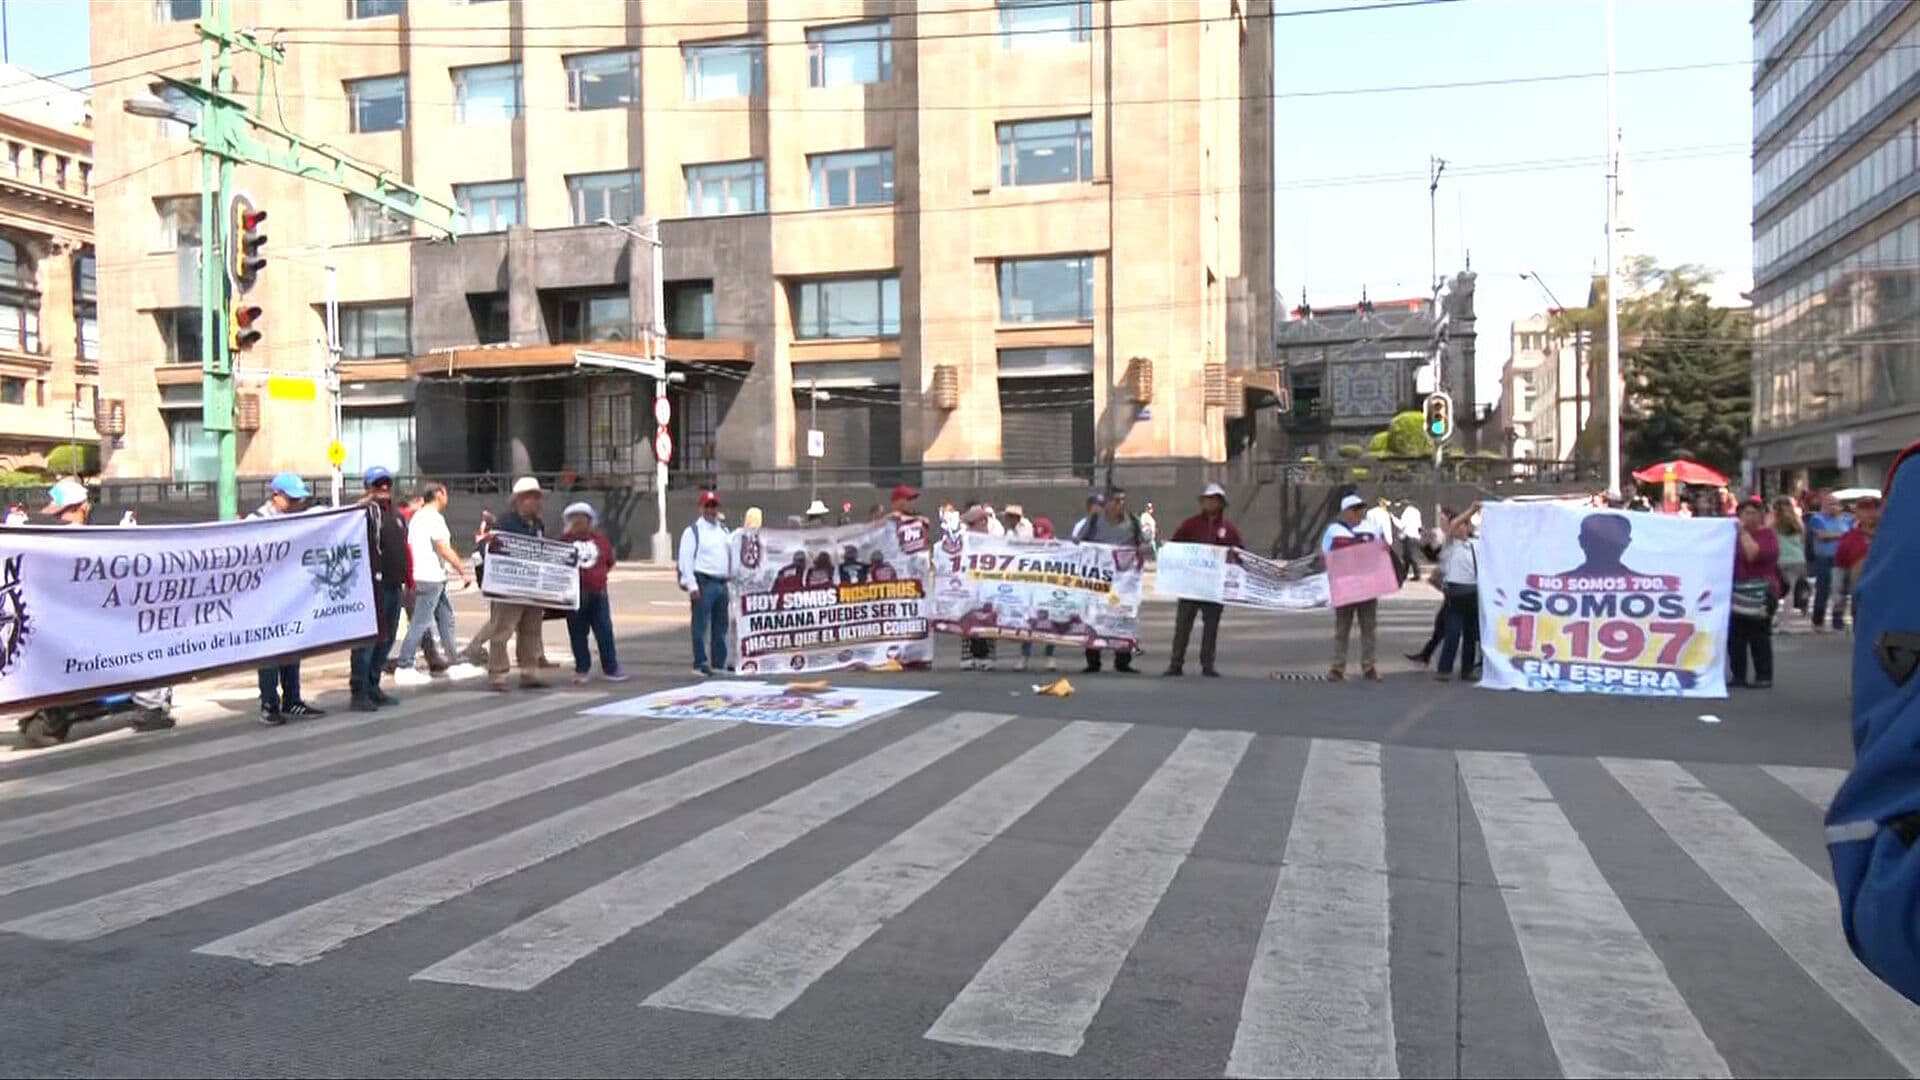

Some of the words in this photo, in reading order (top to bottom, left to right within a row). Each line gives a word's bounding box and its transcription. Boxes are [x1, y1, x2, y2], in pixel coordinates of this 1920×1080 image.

[71, 553, 152, 582] PAGO
[159, 540, 290, 575] INMEDIATO
[301, 544, 362, 566] ESIME
[950, 554, 1015, 574] 1,197
[1018, 558, 1114, 582] FAMILIAS
[102, 584, 120, 608] A
[129, 568, 263, 606] JUBILADOS
[1538, 577, 1563, 590] NO
[1567, 576, 1627, 591] SOMOS
[312, 602, 366, 619] ZACATENCO
[746, 593, 780, 612] HOY
[783, 588, 837, 609] SOMOS
[819, 603, 868, 624] PUEDES
[871, 602, 897, 619] SER
[900, 602, 918, 617] TU
[1517, 589, 1687, 620] SOMOS
[138, 606, 186, 634] DEL
[194, 598, 233, 625] IPN
[65, 650, 144, 673] Profesores
[147, 648, 163, 661] en
[167, 638, 207, 657] activo
[210, 634, 225, 650] de
[229, 631, 240, 646] la
[244, 620, 304, 644] ESIME-Z
[794, 631, 819, 648] QUE
[821, 628, 835, 644] EL
[1507, 613, 1696, 666] 1,197
[1523, 659, 1561, 680] EN
[1569, 663, 1682, 691] ESPERA
